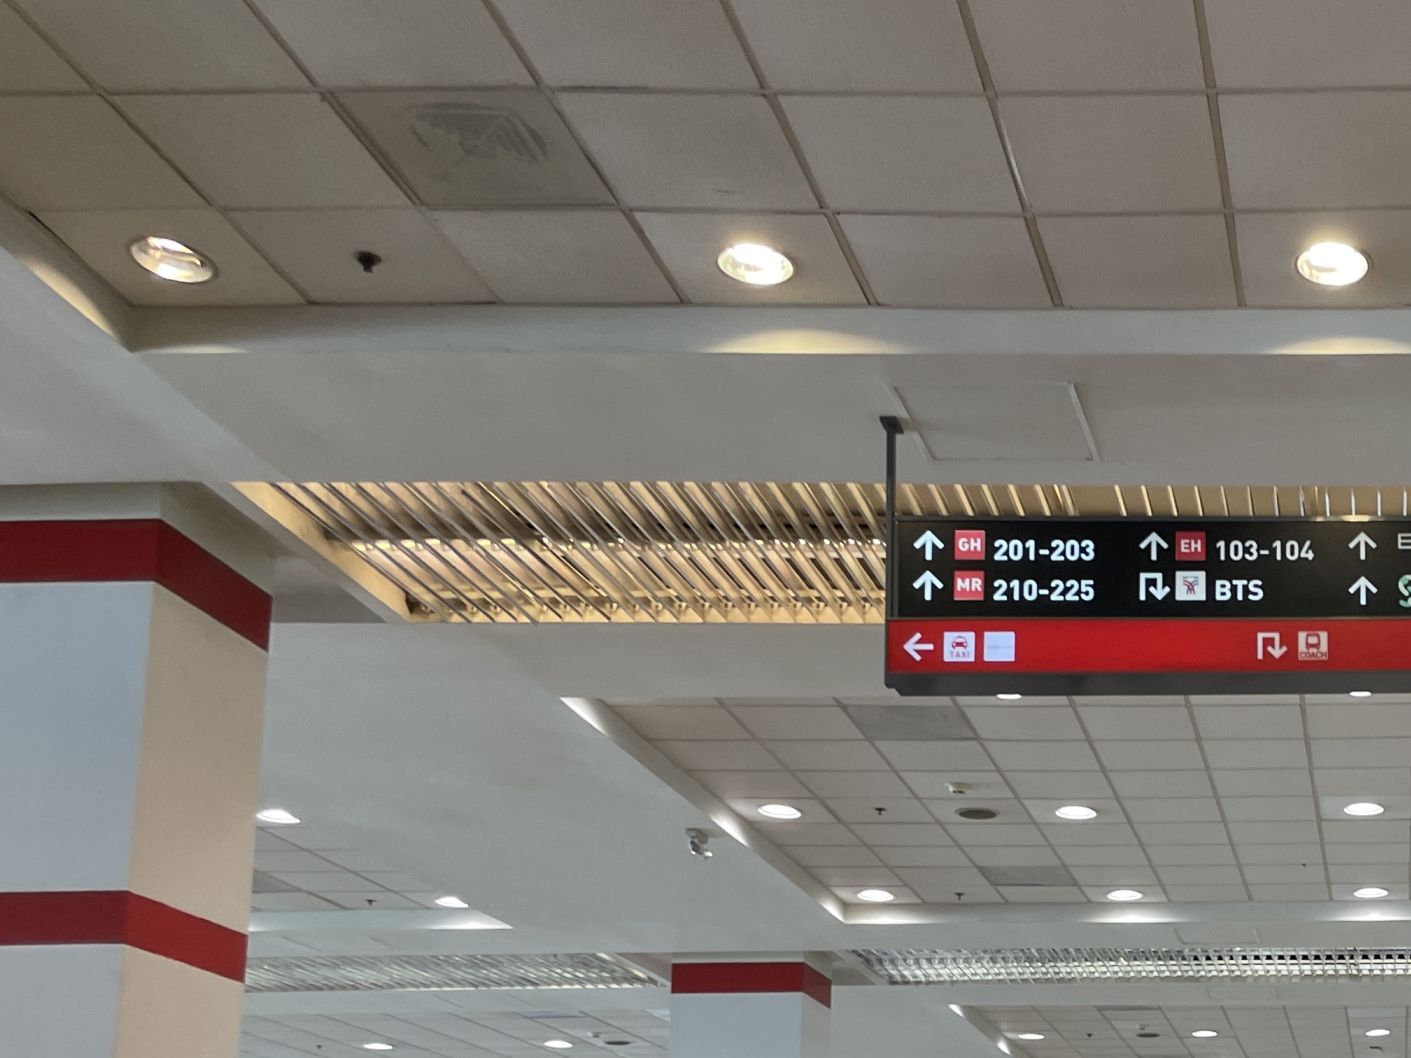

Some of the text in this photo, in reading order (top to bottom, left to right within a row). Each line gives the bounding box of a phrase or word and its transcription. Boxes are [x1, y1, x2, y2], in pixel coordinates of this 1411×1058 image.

[958, 538, 1095, 560] GH 201-203
[1181, 539, 1314, 560] EH 103-104
[956, 578, 1094, 600] MR 210-225
[1216, 580, 1264, 600] BTS
[950, 650, 970, 659] TAXI
[1300, 652, 1328, 660] COACH
